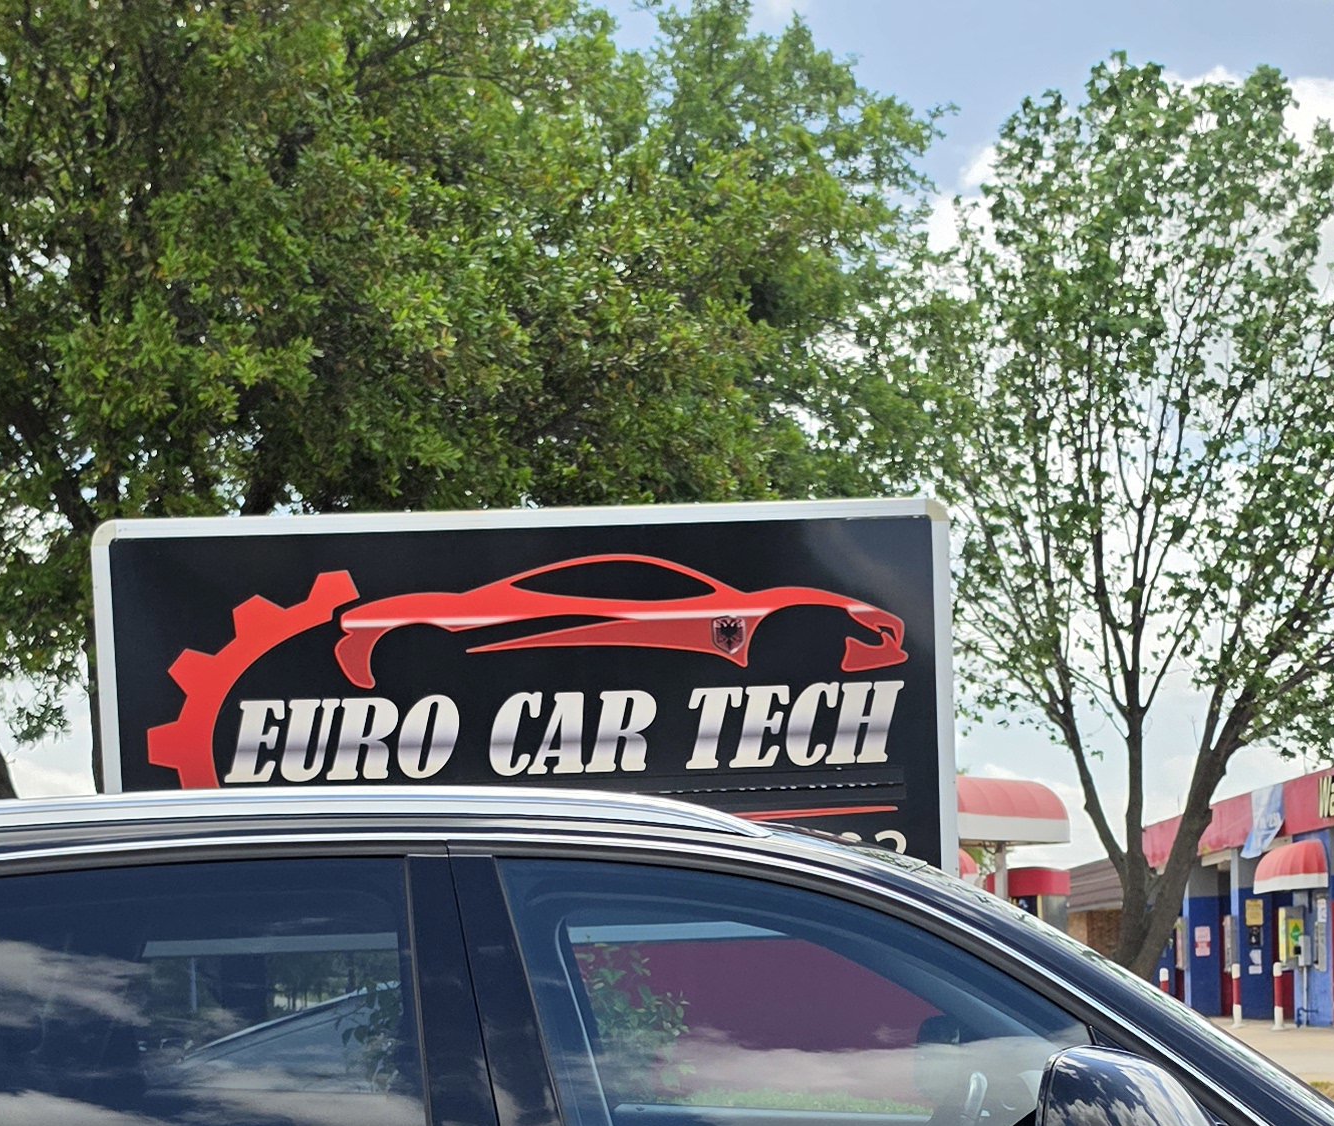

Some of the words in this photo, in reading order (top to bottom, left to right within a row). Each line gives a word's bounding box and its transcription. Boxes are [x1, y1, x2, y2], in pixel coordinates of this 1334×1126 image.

[224, 695, 460, 783] EURO
[489, 690, 657, 776] CAR
[686, 680, 905, 770] TECH
